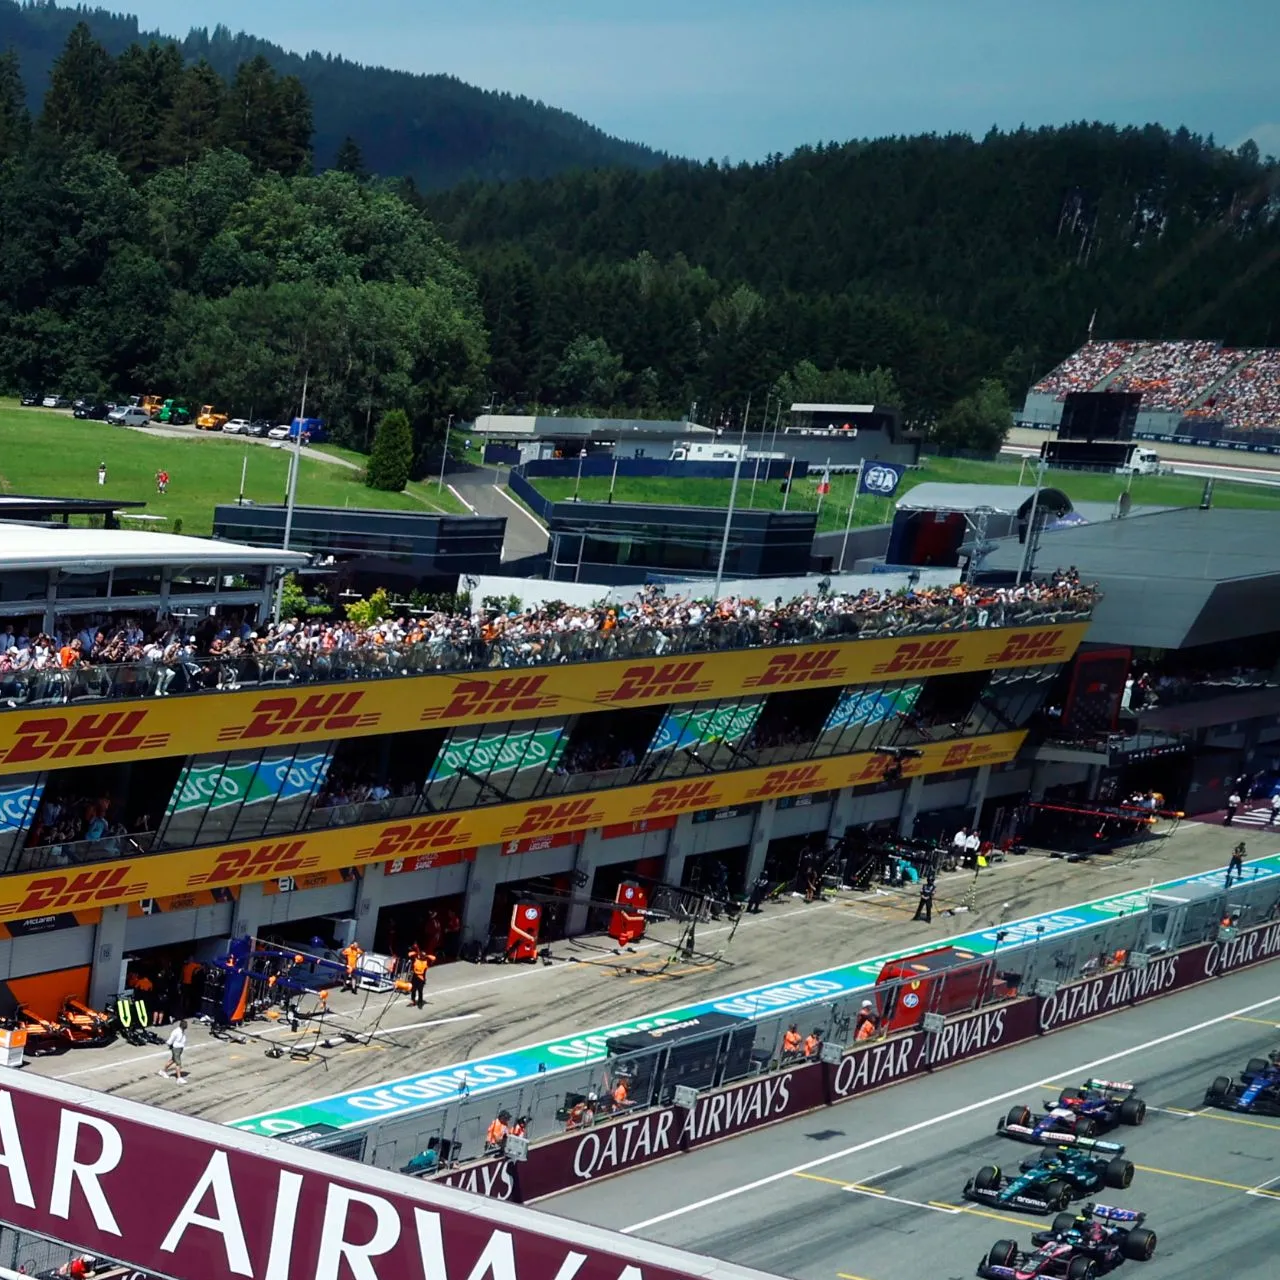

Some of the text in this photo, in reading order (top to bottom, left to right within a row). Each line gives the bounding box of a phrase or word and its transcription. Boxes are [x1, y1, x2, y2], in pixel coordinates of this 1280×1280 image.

[758, 649, 841, 686] DHL
[885, 639, 959, 675] DHL
[997, 630, 1064, 664] DHL
[441, 675, 548, 718] DHL
[615, 661, 706, 700] DHL
[242, 690, 363, 738] DHL
[5, 710, 147, 763] DHL
[642, 780, 715, 813] DHL
[759, 765, 826, 799] DHL
[517, 798, 596, 835] DHL
[370, 818, 460, 858] DHL
[208, 841, 306, 882] DHL
[18, 868, 127, 912] DHL
[23, 915, 56, 926] McLaren
[1204, 933, 1256, 977] QATAR
[714, 978, 843, 1020] aramco
[1041, 954, 1179, 1030] QATAR AIRWAYS
[834, 1007, 1006, 1096] QATAR AIRWAYS
[348, 1062, 519, 1112] aramco
[573, 1072, 792, 1179] QATAR AIRWAYS
